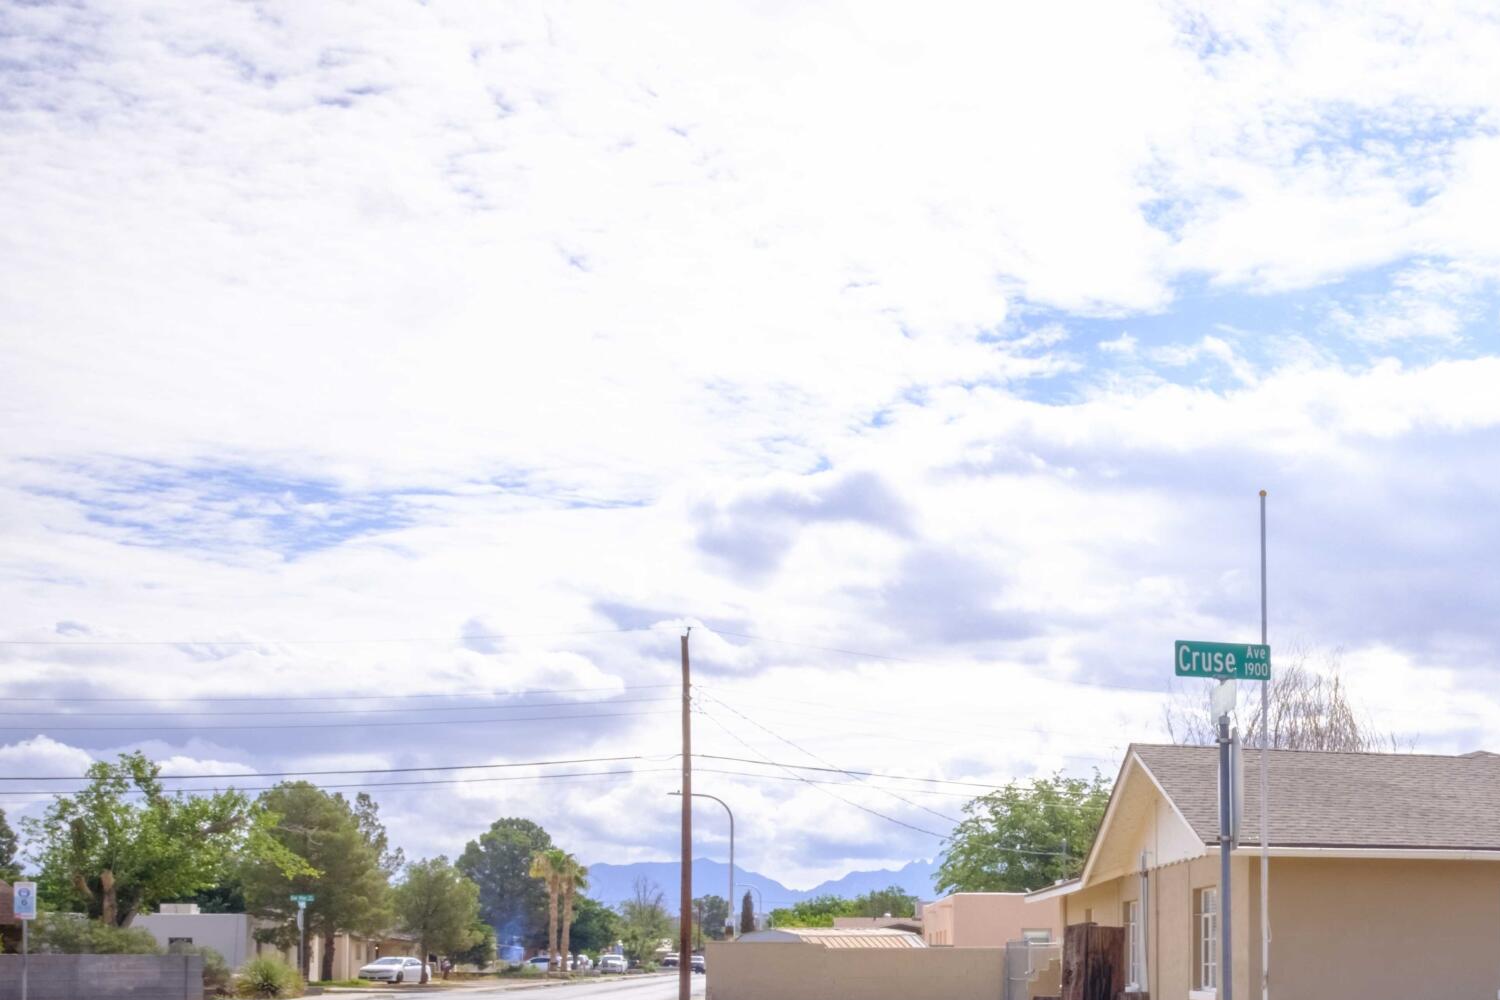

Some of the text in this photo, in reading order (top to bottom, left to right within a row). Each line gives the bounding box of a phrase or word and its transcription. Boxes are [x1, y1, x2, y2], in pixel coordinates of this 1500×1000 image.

[1178, 644, 1266, 673] Cruse Ave
[1244, 662, 1268, 677] 1900
